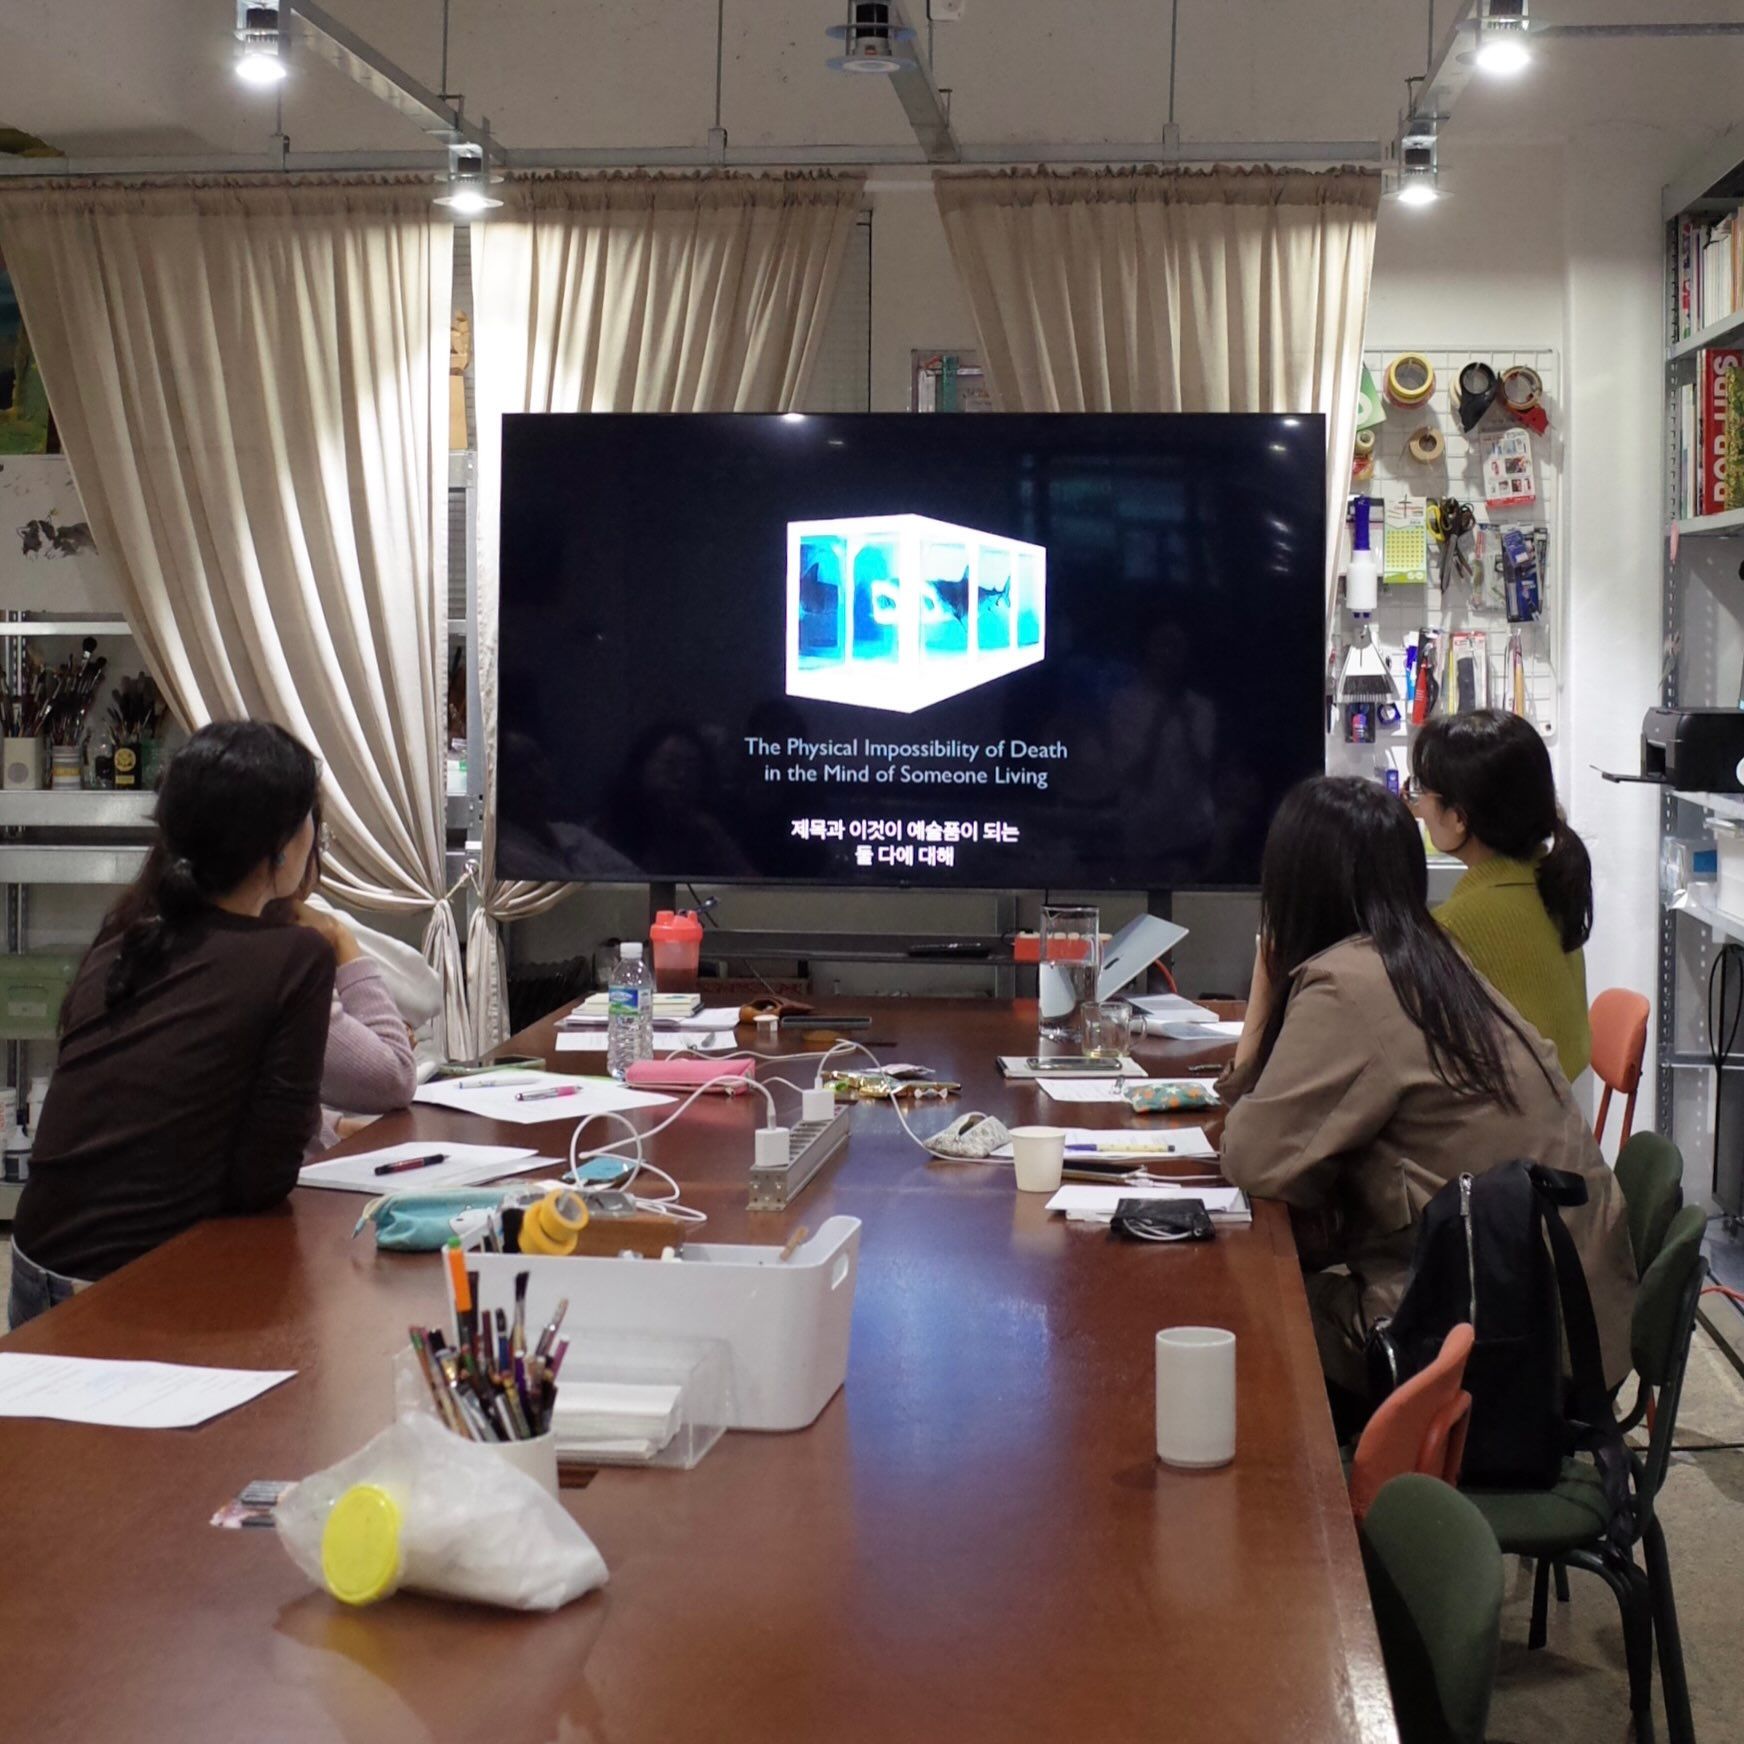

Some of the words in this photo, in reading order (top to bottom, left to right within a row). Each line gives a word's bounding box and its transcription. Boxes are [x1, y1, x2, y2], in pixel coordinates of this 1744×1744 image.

[744, 737, 781, 756] The
[787, 737, 858, 761] Physical
[864, 738, 980, 763] Impossibility
[985, 740, 1005, 758] of
[1010, 740, 1068, 759] Death
[764, 764, 781, 782] in
[787, 763, 818, 782] the
[823, 764, 869, 783] Mind
[875, 764, 896, 782] of
[900, 765, 988, 784] Someone
[995, 766, 1049, 790] Living
[791, 818, 846, 841] 제목과
[849, 819, 903, 841] 이것이
[906, 820, 978, 842] 예술품이
[983, 821, 1020, 843] 되는
[877, 845, 914, 867] 다에
[918, 845, 955, 867] 대해
